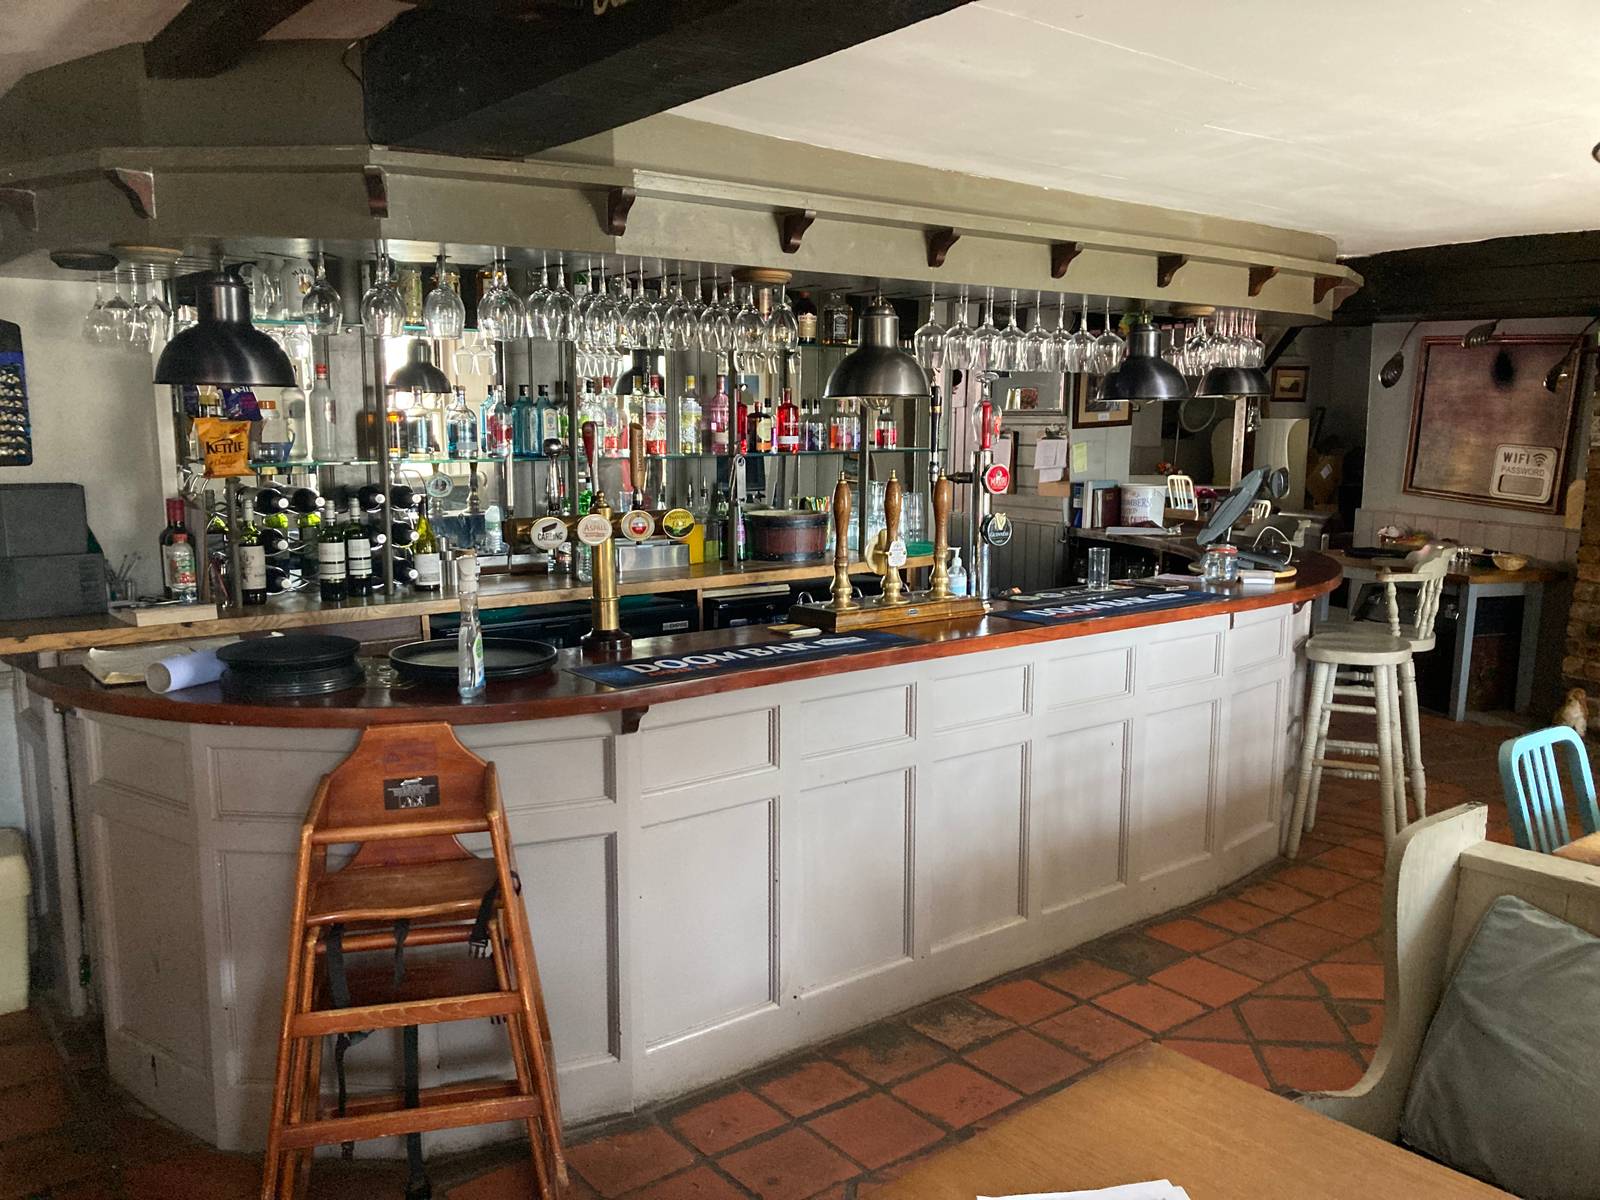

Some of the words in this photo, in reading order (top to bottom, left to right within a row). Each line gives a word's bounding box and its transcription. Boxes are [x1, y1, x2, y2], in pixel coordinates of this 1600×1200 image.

[206, 439, 245, 455] KETTLE
[1503, 452, 1531, 464] WIFI
[1500, 465, 1545, 477] PASSWORD
[623, 650, 750, 674] DOOM
[738, 641, 822, 657] BAR
